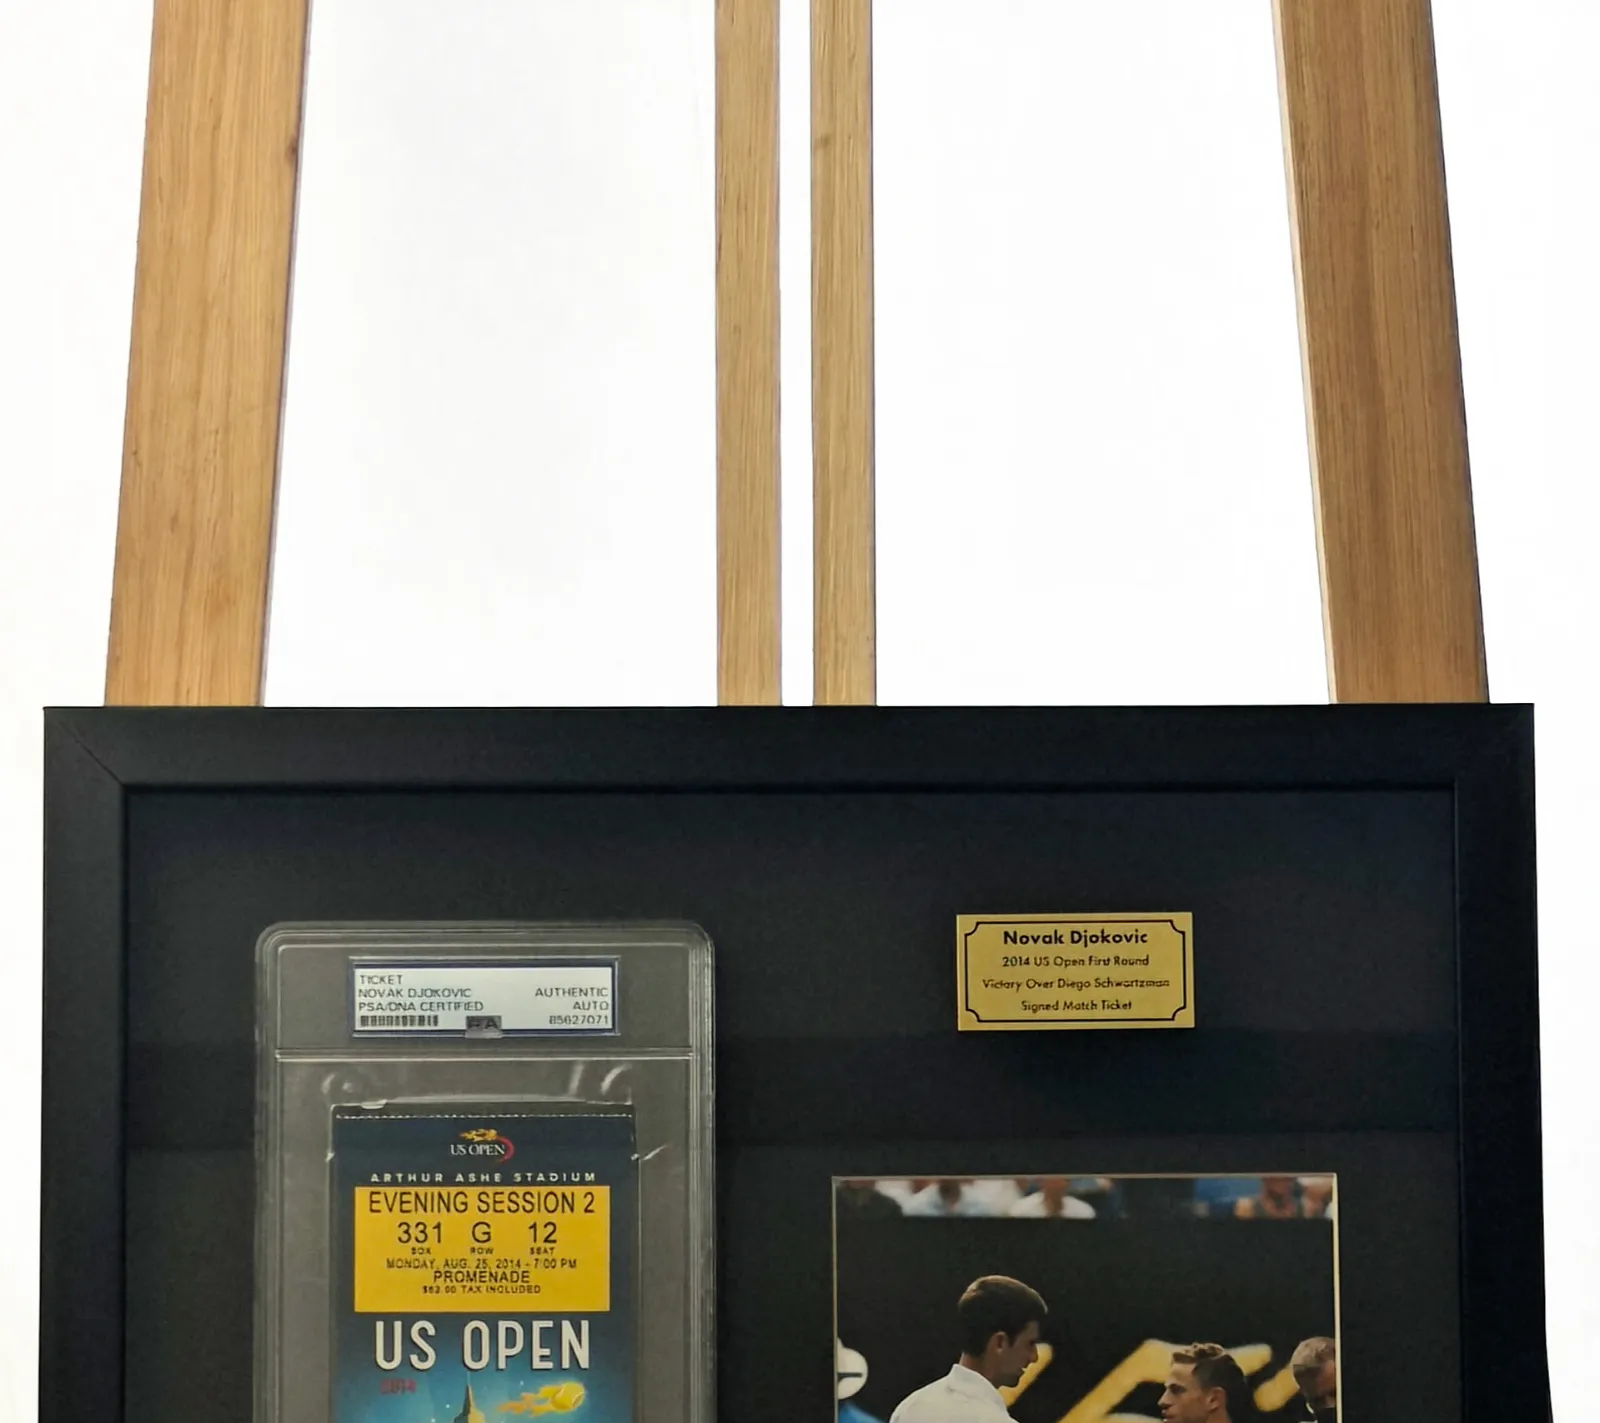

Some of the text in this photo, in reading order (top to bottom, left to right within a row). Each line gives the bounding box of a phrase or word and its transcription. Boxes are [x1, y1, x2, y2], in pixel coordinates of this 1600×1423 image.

[1003, 929, 1148, 948] Novak Djokovic
[1002, 954, 1149, 969] 2014 US Open First Round
[360, 974, 402, 985] TICKET
[983, 977, 1170, 992] Victory Over Diego Schwartzman
[358, 987, 472, 998] NOVAK DJOKOVIC
[535, 987, 609, 998] AUTHENTIC
[358, 1001, 484, 1012] PSA/DNA CERTIFIED
[572, 1001, 609, 1011] AUTO
[1021, 1000, 1132, 1014] Signed Match Ticket
[450, 1144, 505, 1156] US OPEN
[371, 1171, 596, 1183] ARTHUR ASHE STADIUM
[369, 1190, 595, 1213] EVENING SESSION 2
[397, 1221, 557, 1244] 331 G 12
[411, 1247, 555, 1255] BOX ROW SEAT
[496, 1258, 522, 1269] 2014
[561, 1258, 577, 1269] PM
[433, 1270, 530, 1283] PROMENADE
[461, 1284, 482, 1294] TAX
[486, 1284, 541, 1294] INCLUDED
[375, 1320, 590, 1370] US OPEN
